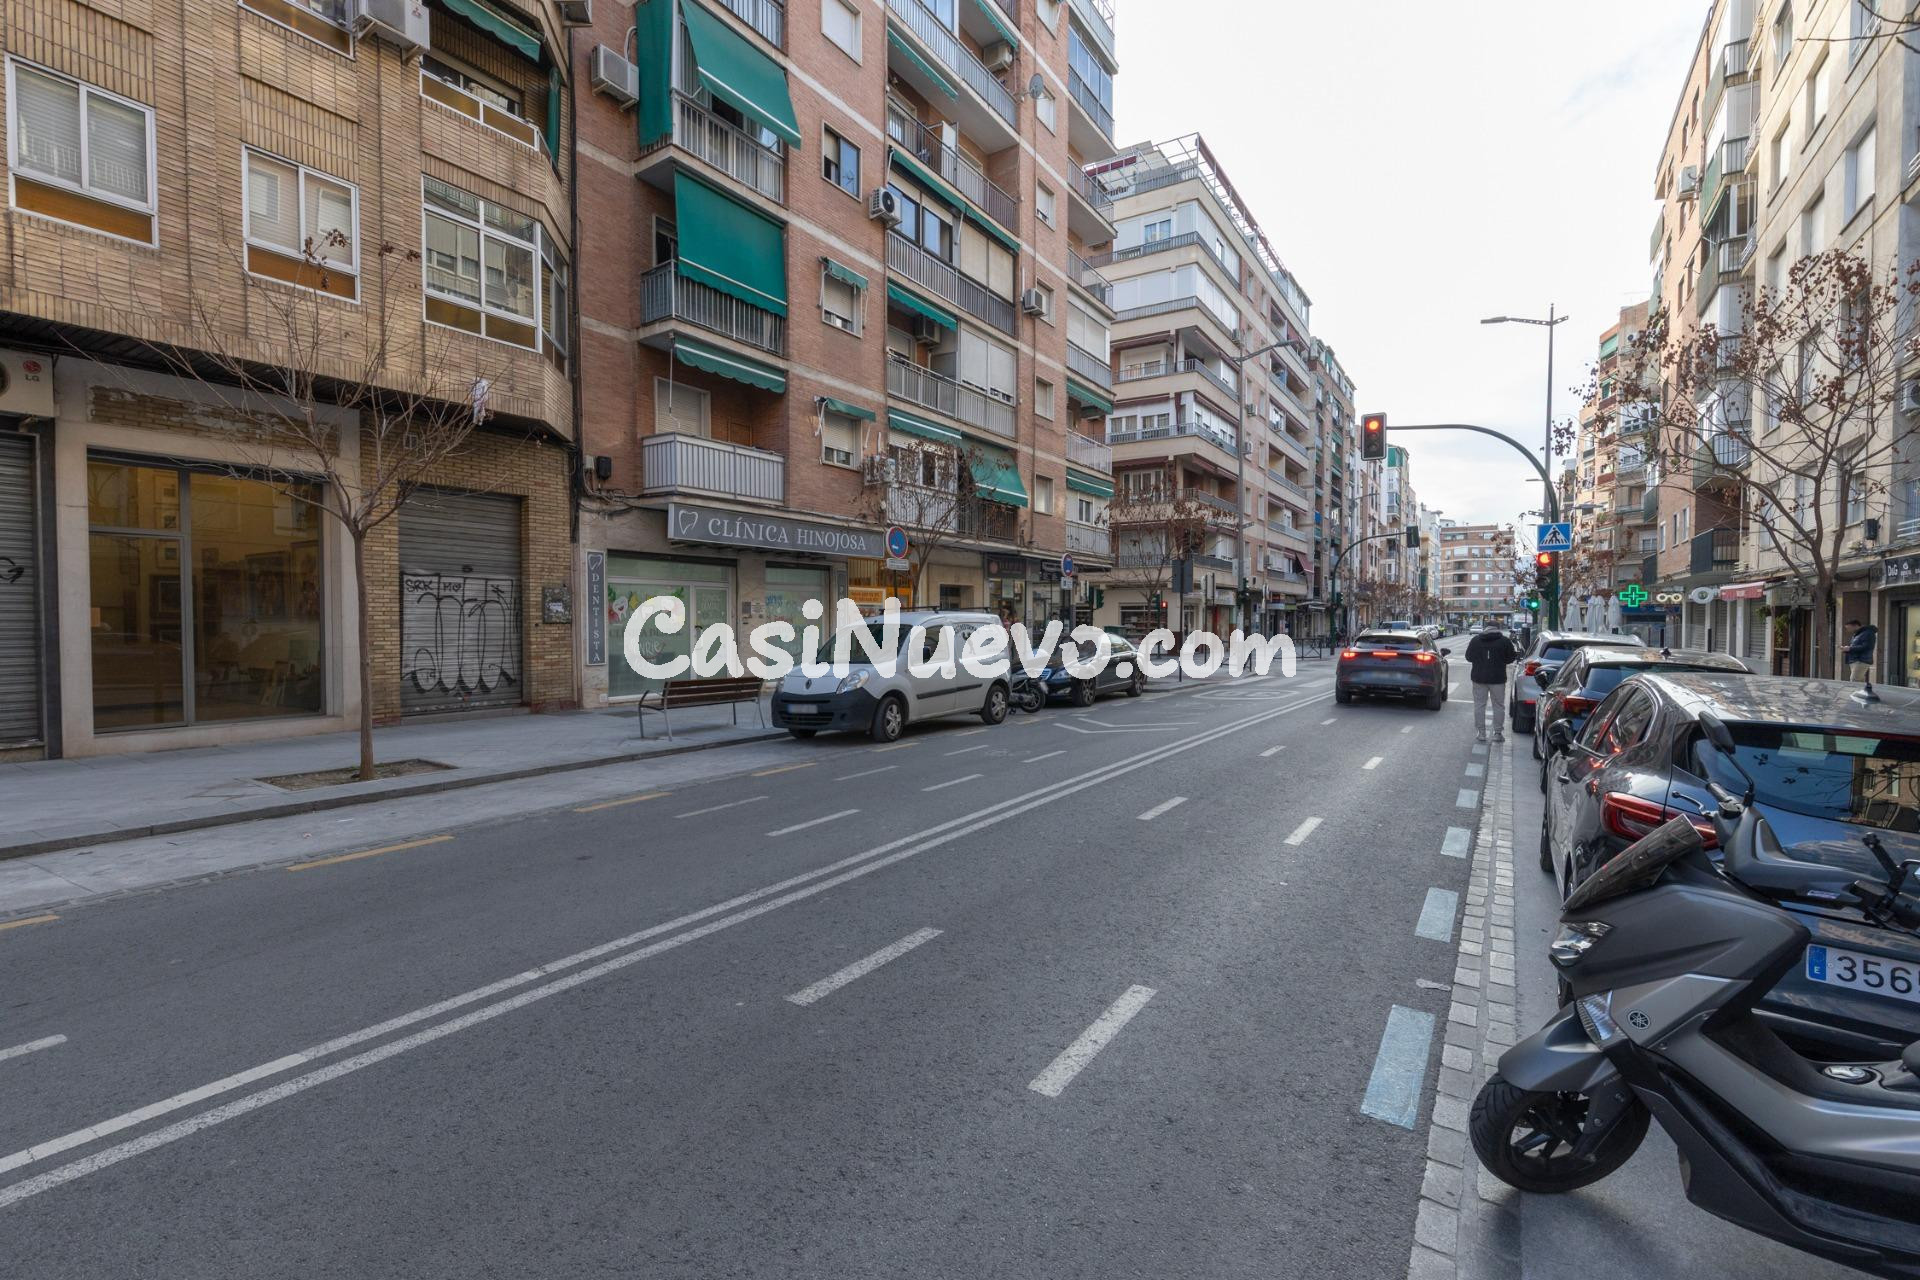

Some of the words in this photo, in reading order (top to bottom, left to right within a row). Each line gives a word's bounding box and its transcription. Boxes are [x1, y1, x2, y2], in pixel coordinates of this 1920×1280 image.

[25, 373, 40, 382] LG
[708, 516, 789, 544] CLÍNICA
[797, 528, 867, 551] HINOJOSA
[591, 573, 601, 662] DENTISTA
[1813, 966, 1821, 974] E
[1836, 955, 1920, 995] 356
